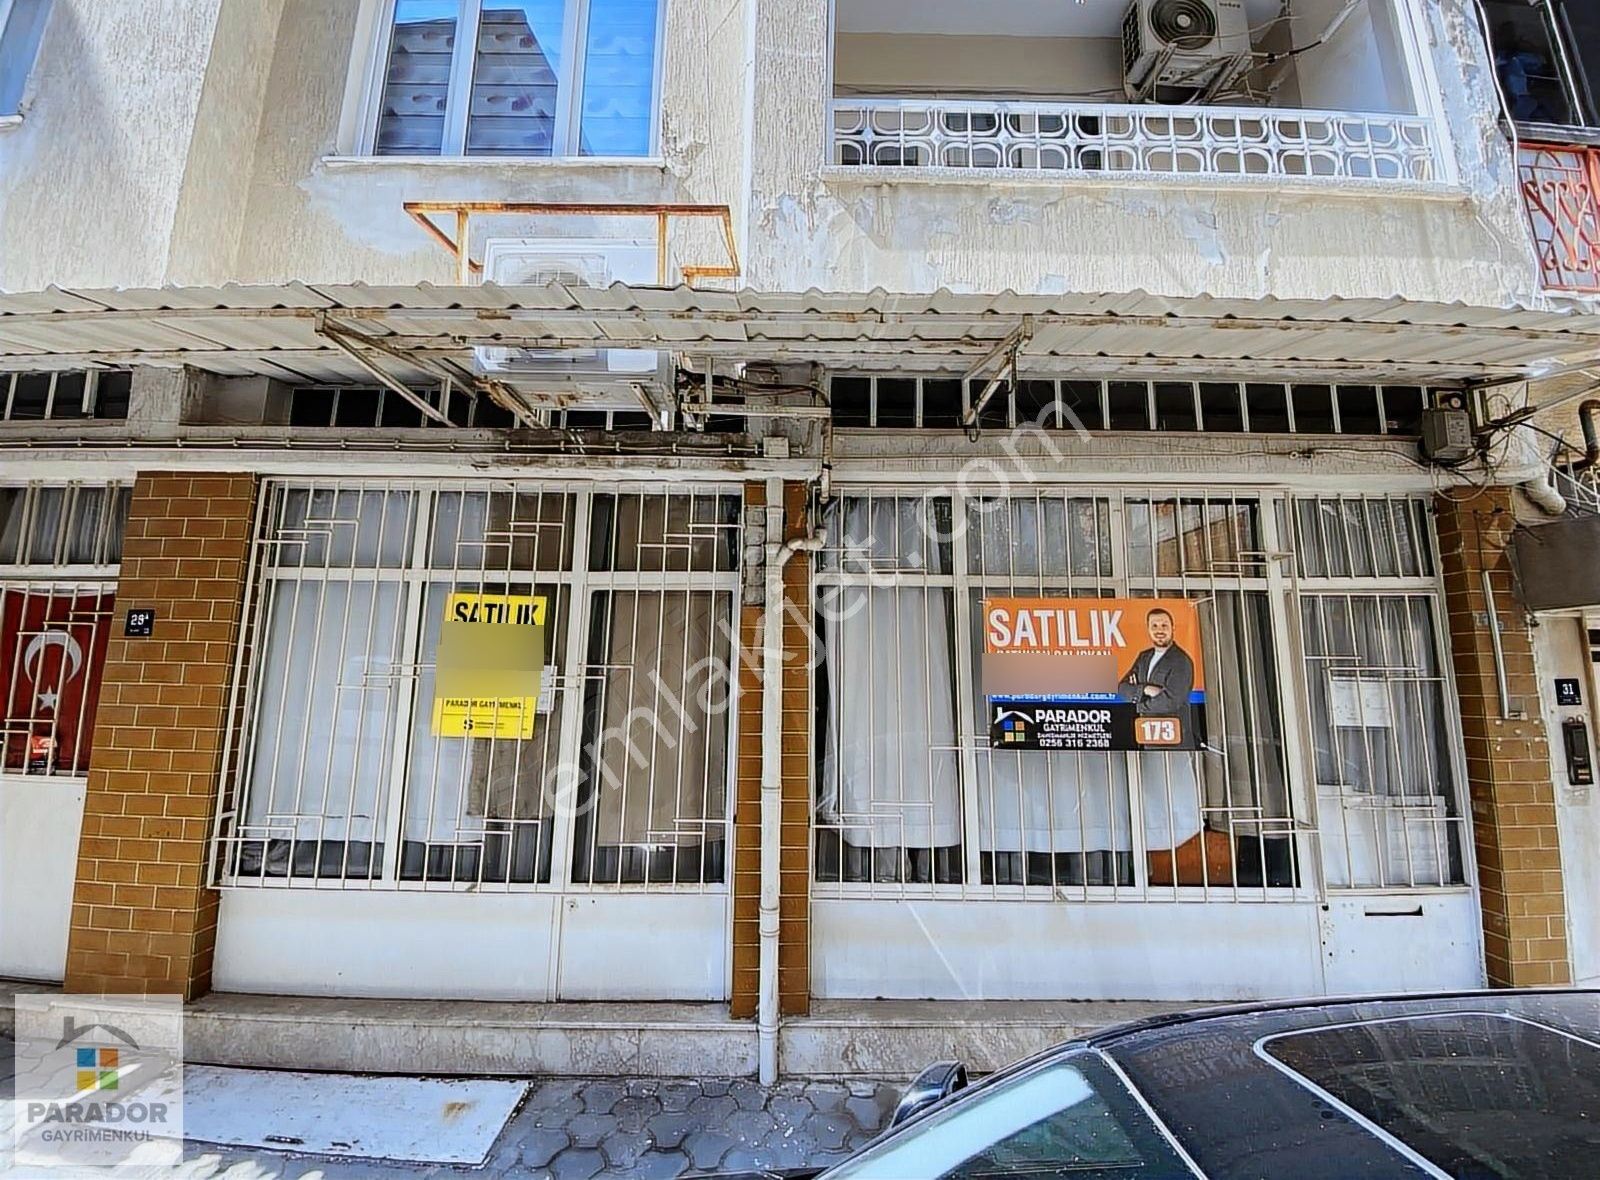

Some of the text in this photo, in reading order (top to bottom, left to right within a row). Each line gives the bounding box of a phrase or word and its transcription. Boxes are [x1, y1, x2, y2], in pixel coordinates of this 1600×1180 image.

[988, 607, 1128, 649] SATILIK
[1562, 683, 1574, 695] 31
[1035, 709, 1111, 723] PARADOR
[1140, 720, 1175, 741] 173
[1039, 739, 1063, 747] 0256
[1065, 739, 1083, 748] 316
